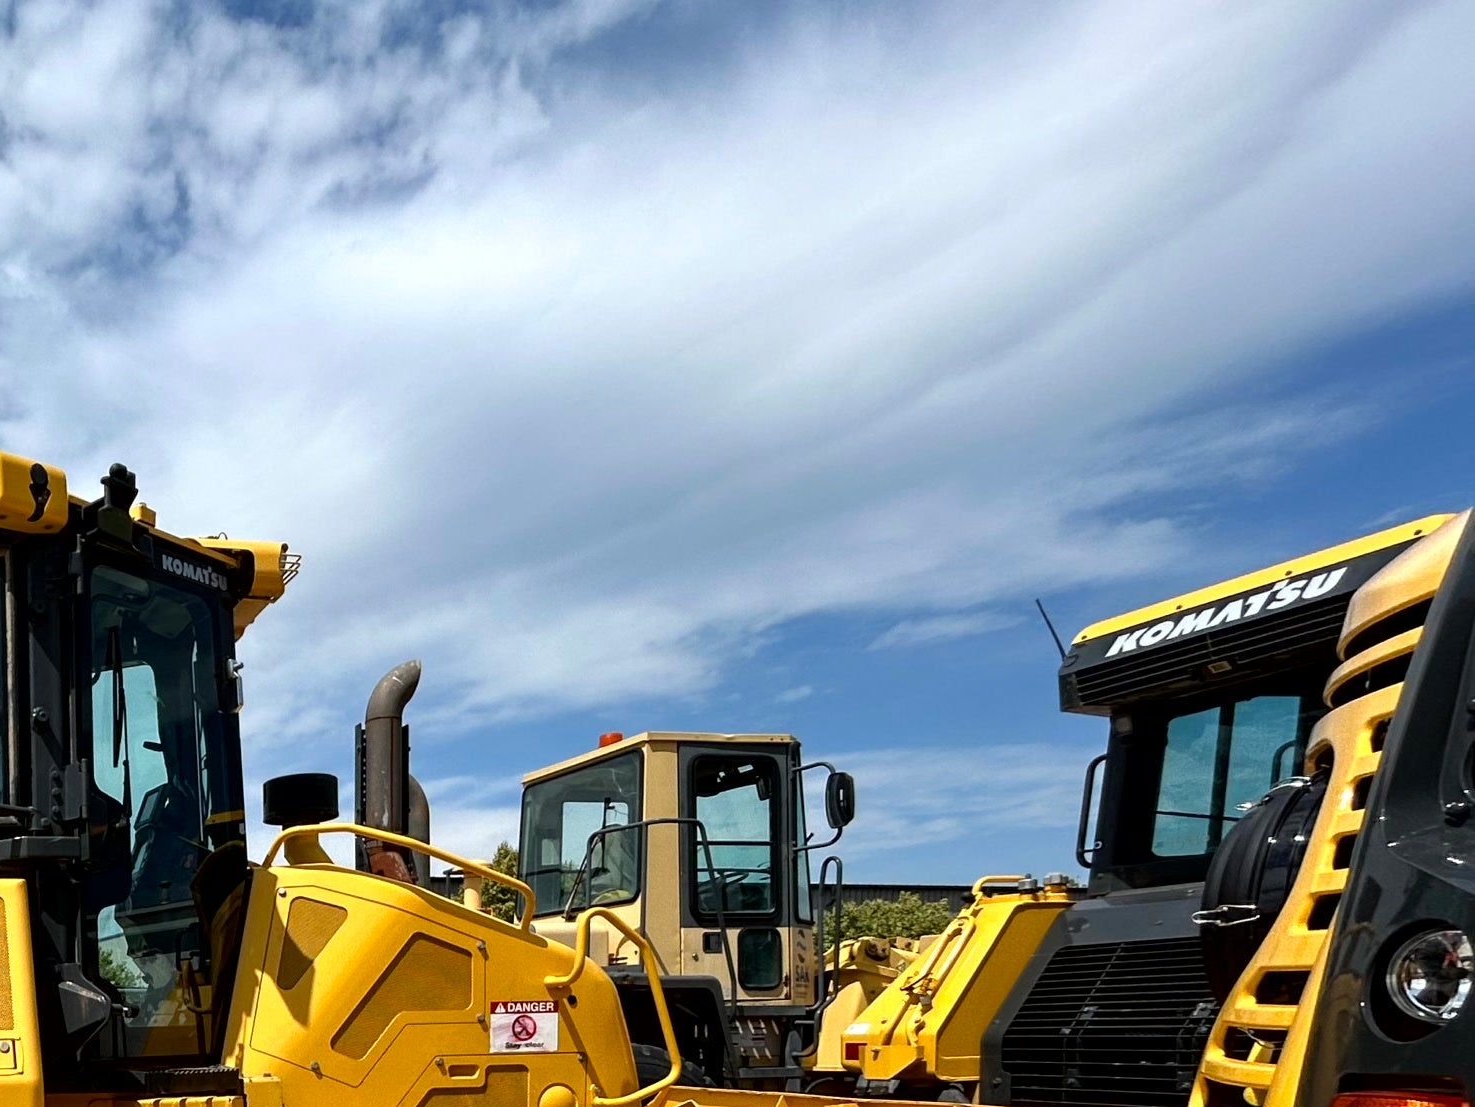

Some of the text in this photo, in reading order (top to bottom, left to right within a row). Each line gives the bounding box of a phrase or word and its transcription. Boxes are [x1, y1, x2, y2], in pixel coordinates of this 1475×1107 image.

[162, 554, 228, 591] KOMATSU
[1104, 566, 1348, 658] KOMATSU
[507, 1002, 554, 1012] DANGER
